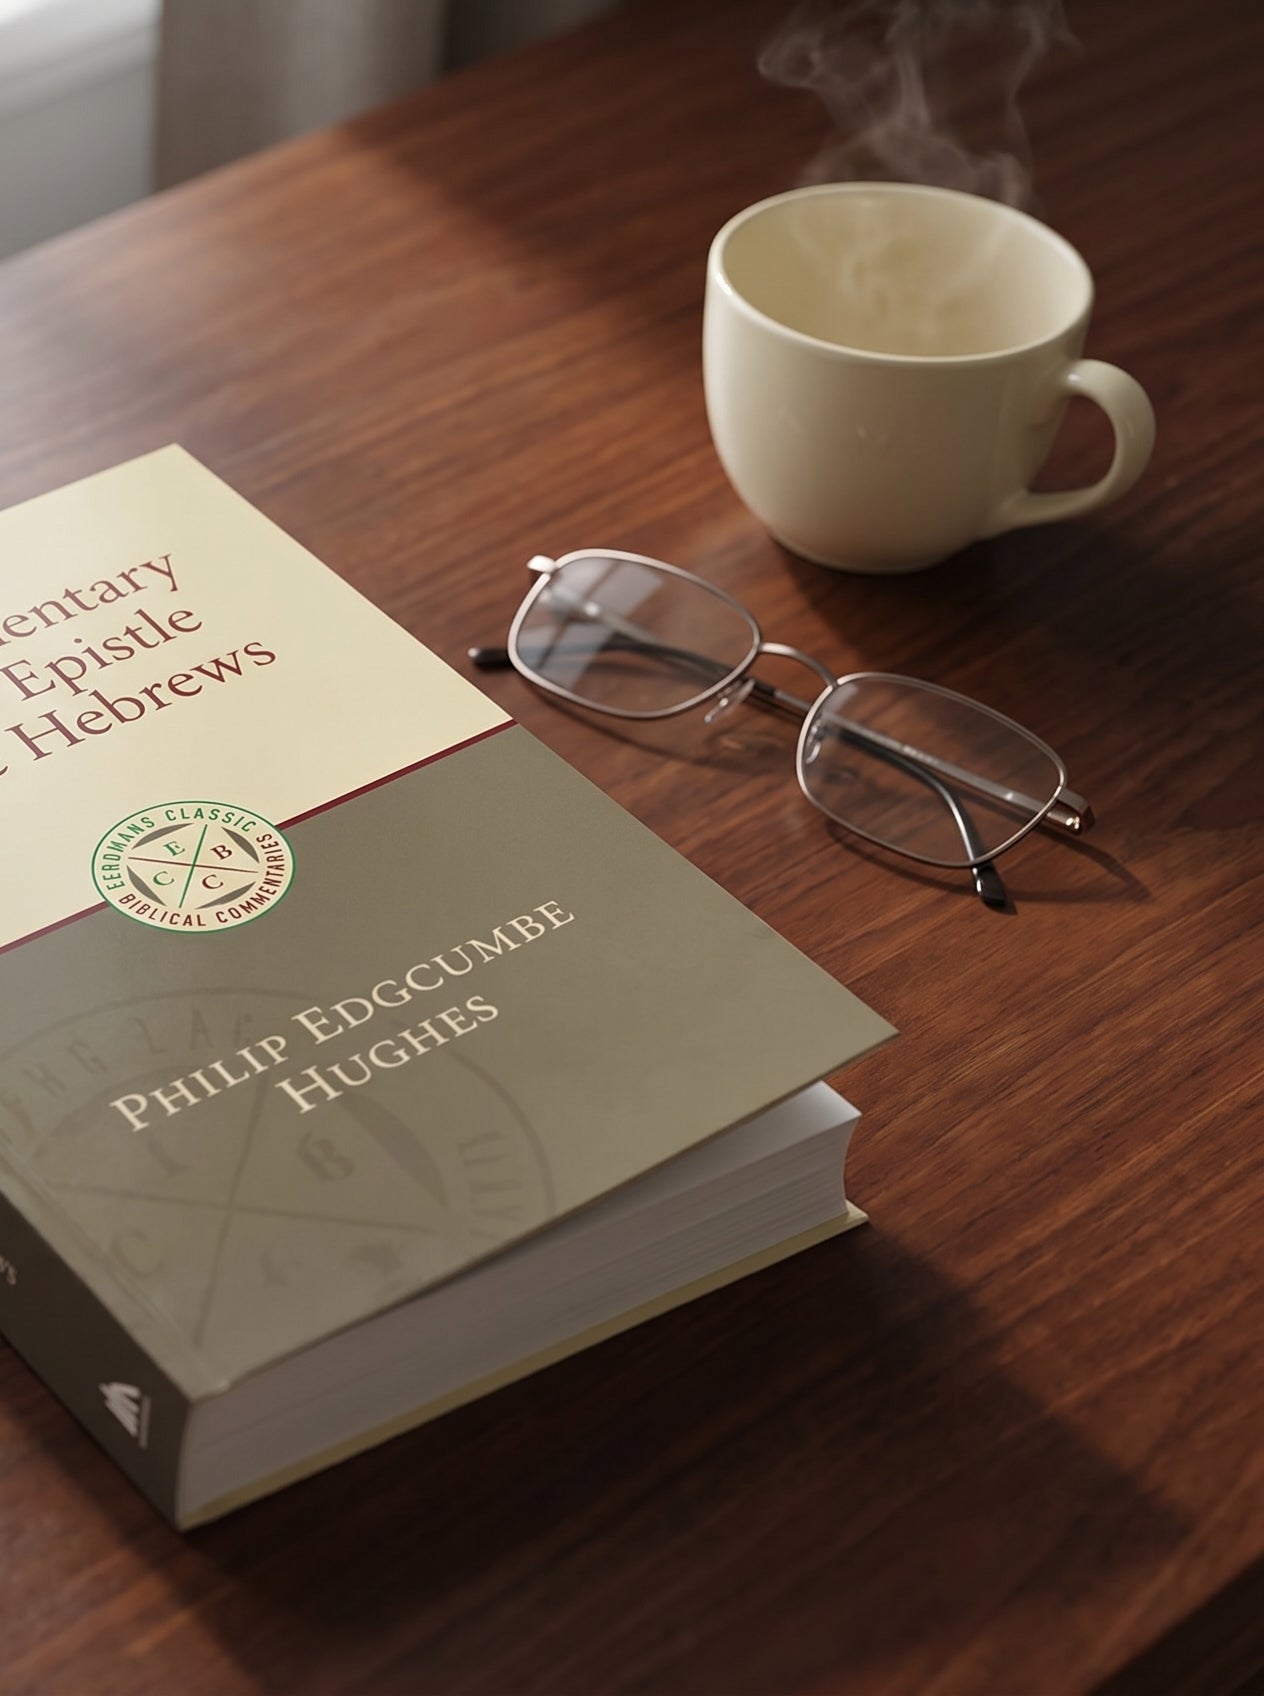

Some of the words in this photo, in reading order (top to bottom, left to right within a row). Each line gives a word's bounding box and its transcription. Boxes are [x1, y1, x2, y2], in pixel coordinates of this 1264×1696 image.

[5, 640, 277, 761] Hebrews
[102, 816, 156, 891] EERDMANS
[164, 808, 257, 832] CLASSIC
[118, 893, 207, 927] BIBLICAL
[215, 833, 285, 924] COMMENTARIES
[152, 871, 175, 887] C
[201, 874, 224, 890] C
[163, 841, 186, 857] E
[209, 844, 233, 861] B
[108, 1034, 288, 1133] PHILIP
[291, 900, 576, 1045] EDGCUMBE
[274, 994, 500, 1114] HUGHES
